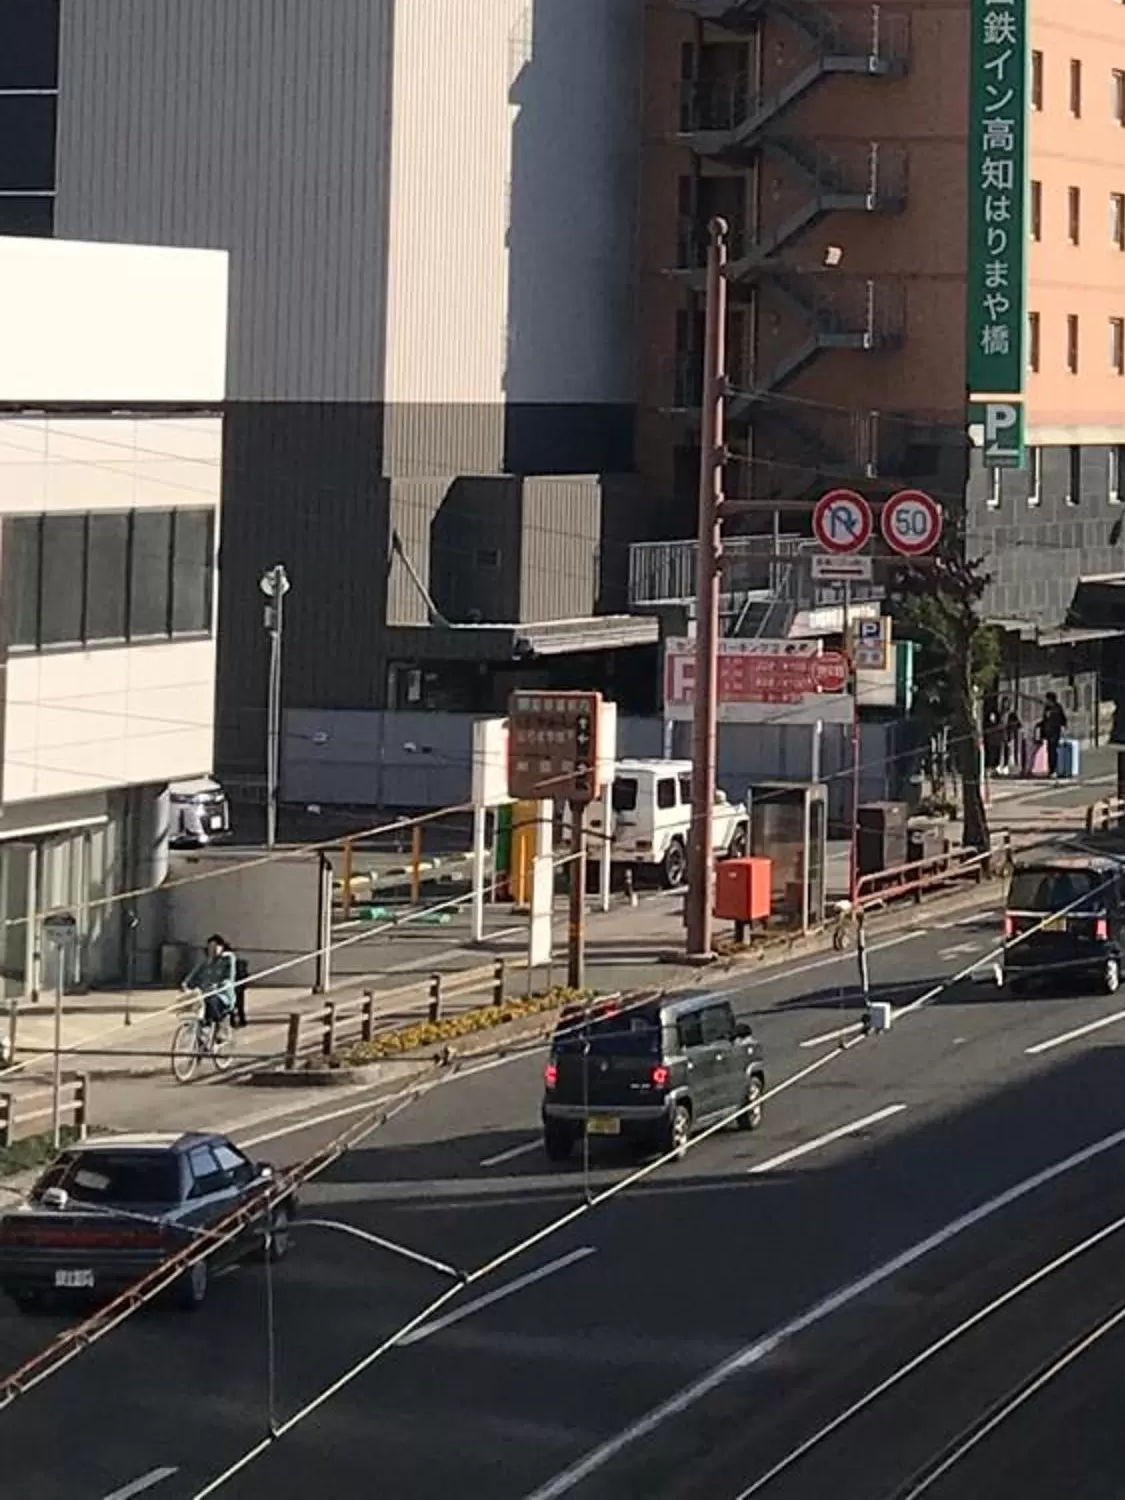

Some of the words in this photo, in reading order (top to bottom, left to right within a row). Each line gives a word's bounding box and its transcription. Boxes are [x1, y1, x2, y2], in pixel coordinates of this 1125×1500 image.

[985, 402, 1018, 442] P
[894, 507, 929, 536] 50
[861, 622, 878, 638] P
